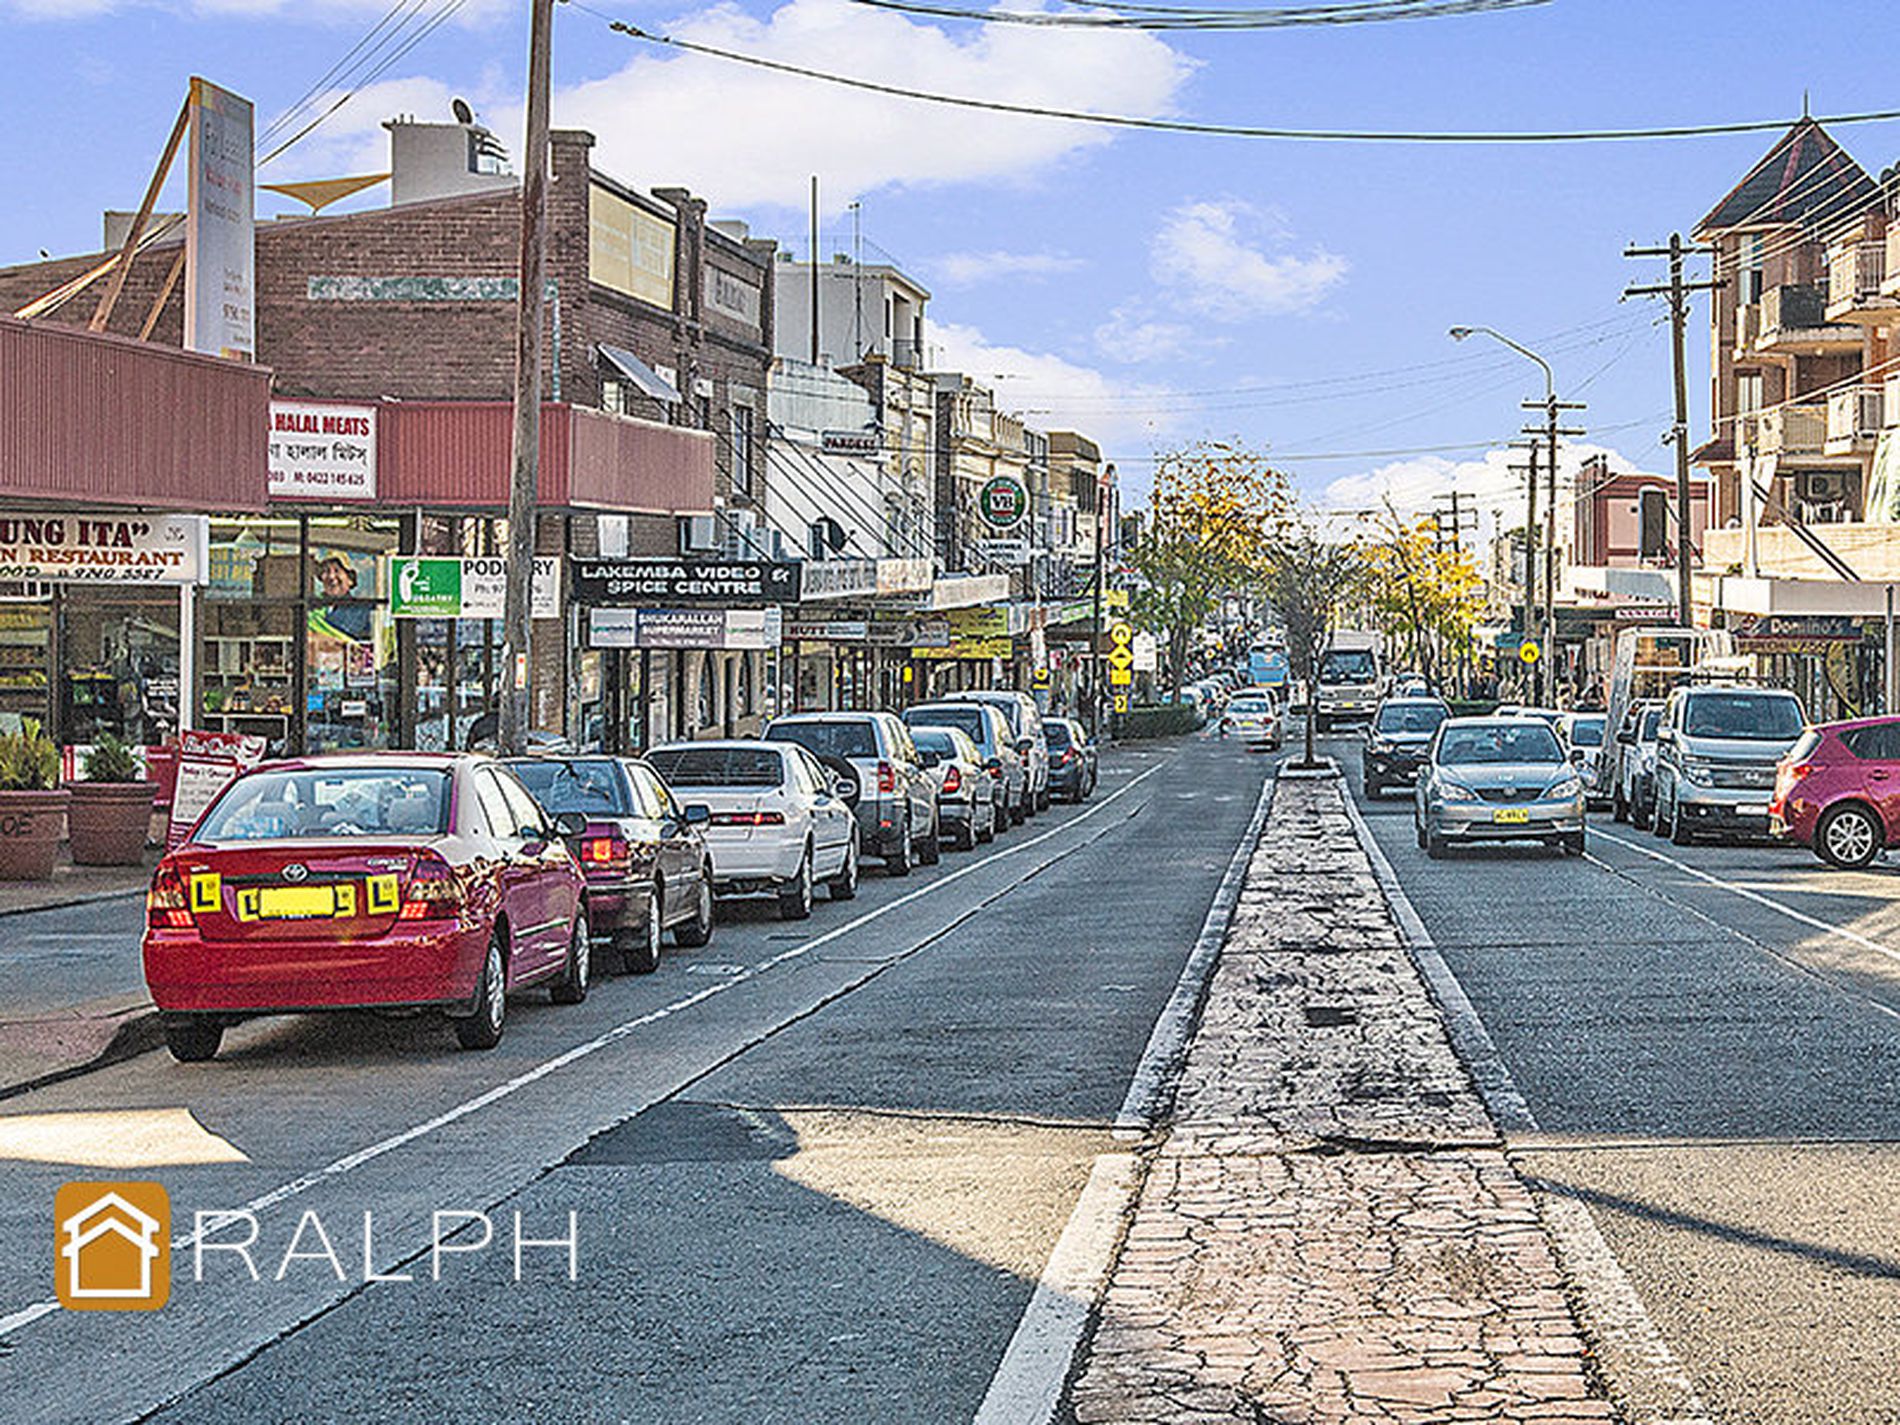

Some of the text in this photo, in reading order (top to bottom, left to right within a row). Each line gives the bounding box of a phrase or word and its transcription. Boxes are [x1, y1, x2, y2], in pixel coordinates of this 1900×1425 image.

[275, 413, 369, 436] HALAL MEATS
[30, 550, 184, 566] RESTAURANT
[581, 566, 687, 579] LAKEMBA
[695, 566, 761, 579] VIDEO
[607, 581, 762, 595] SPICE CENTRE
[1770, 617, 1844, 634] Domino's
[196, 880, 214, 907] L
[374, 880, 393, 907] L
